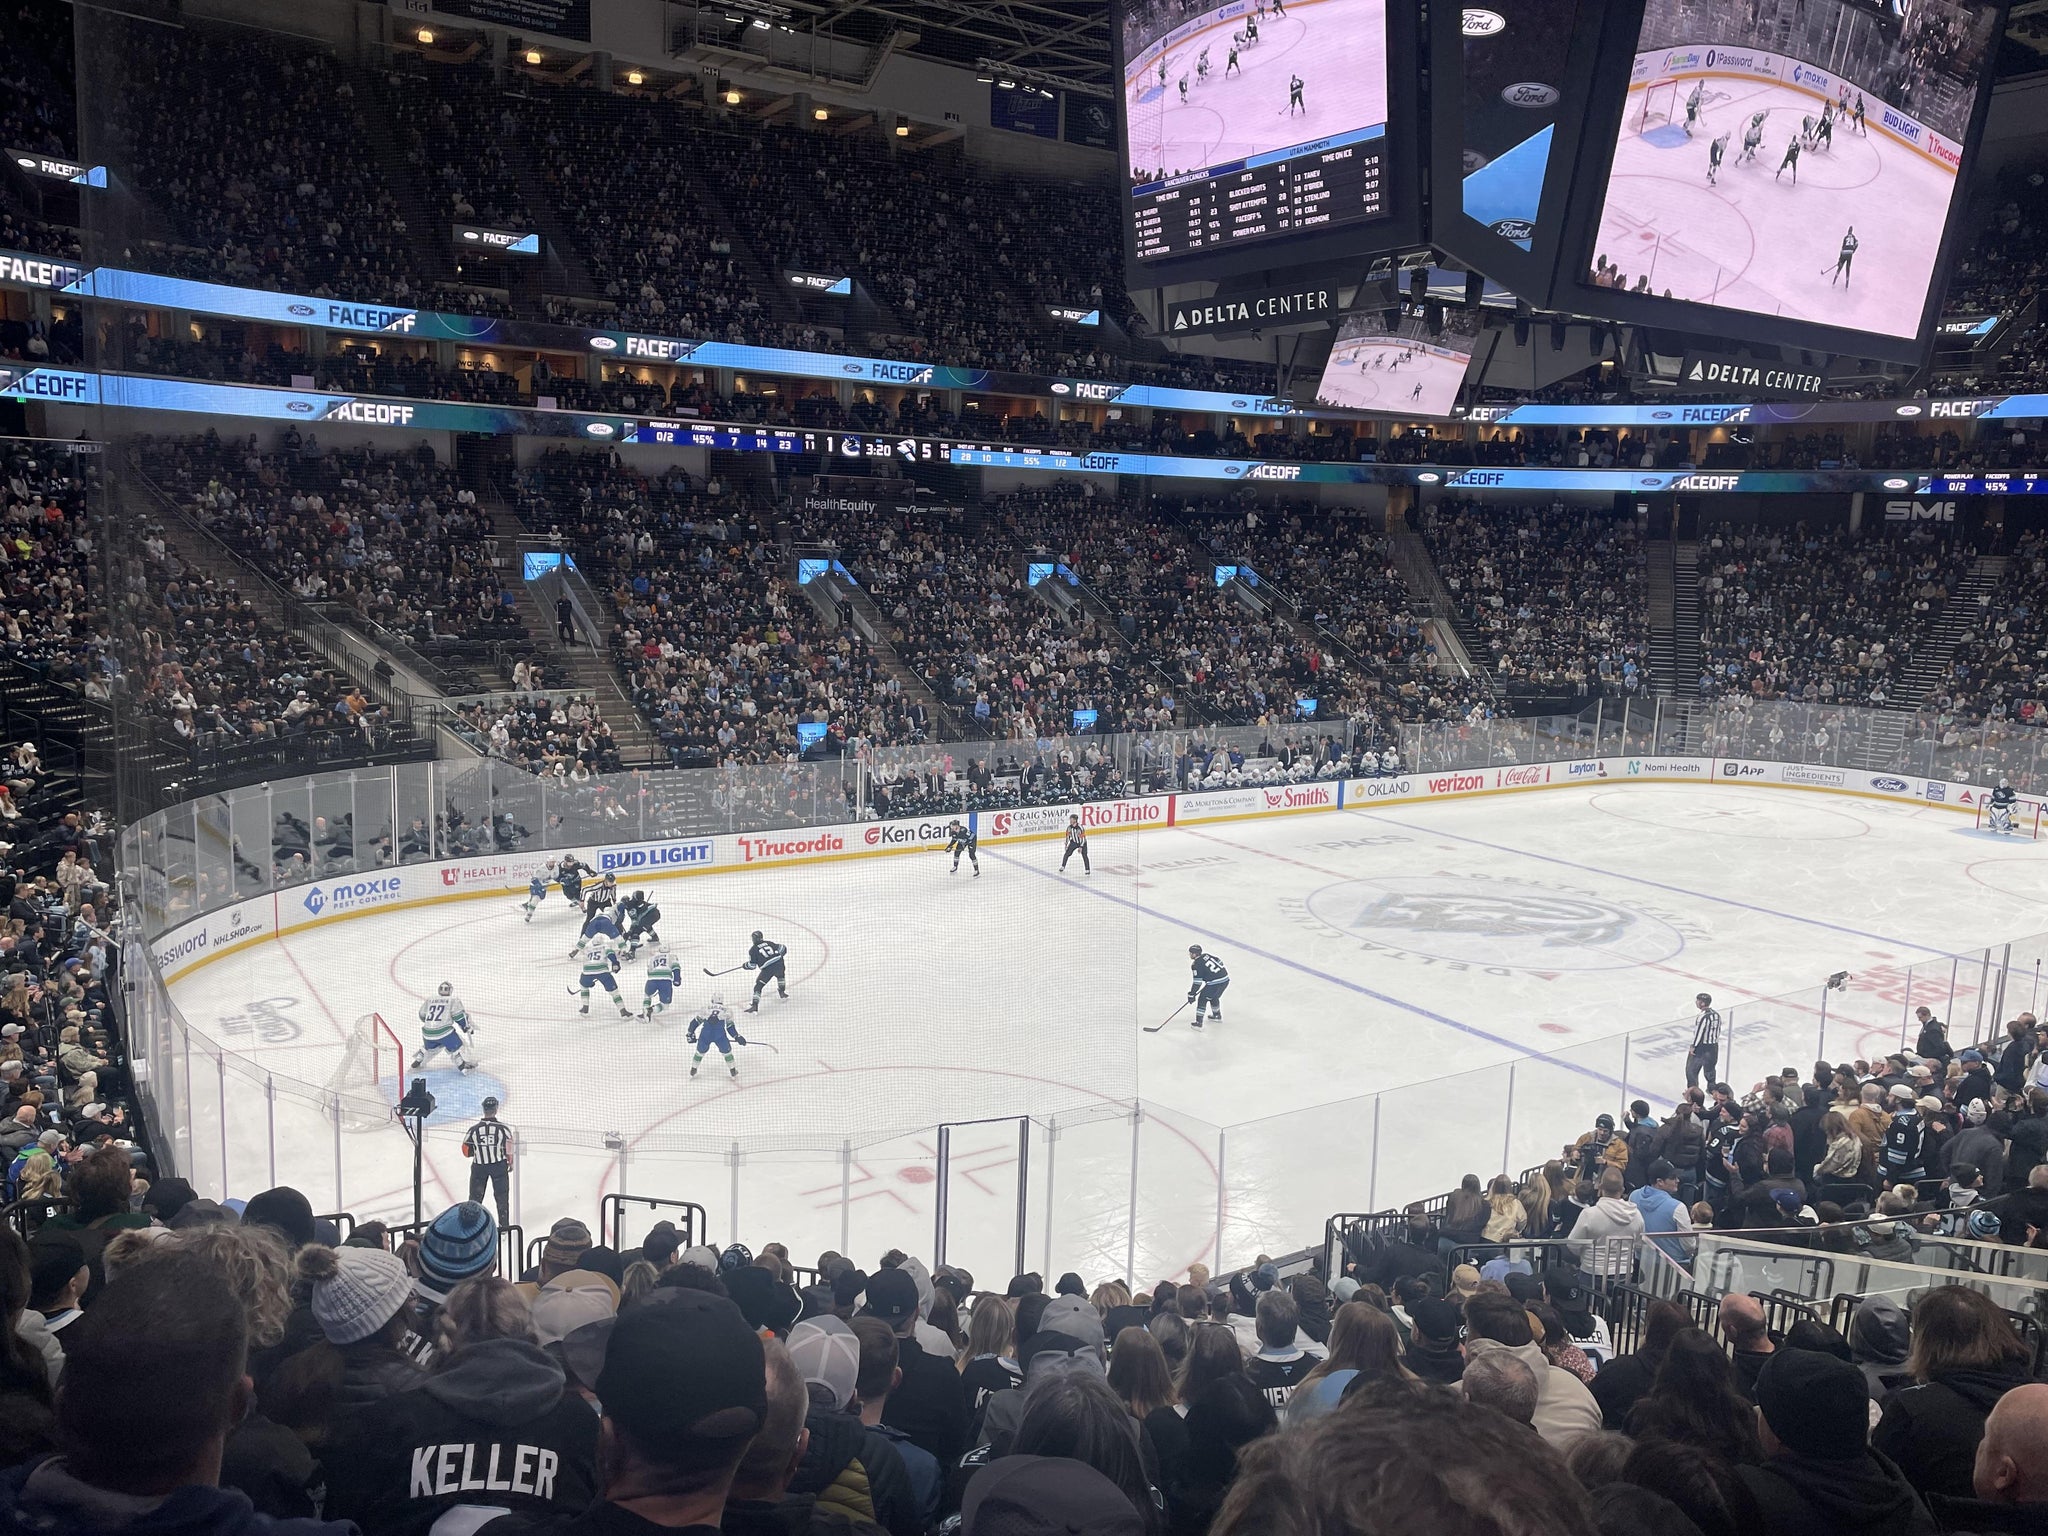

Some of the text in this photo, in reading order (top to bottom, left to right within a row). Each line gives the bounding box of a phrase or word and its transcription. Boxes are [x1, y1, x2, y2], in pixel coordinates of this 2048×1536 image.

[1716, 53, 1753, 68] 1Password
[1804, 69, 1829, 87] moxie
[1884, 111, 1920, 140] BUD LIGHT
[1289, 140, 1330, 156] UTAH MAMMOTH
[1321, 152, 1335, 163] TIME
[1344, 148, 1353, 158] ICE
[1241, 172, 1253, 182] HITS
[1278, 164, 1286, 173] 10
[1294, 156, 1379, 182] 13 TANEV 5:10
[1303, 168, 1379, 191] O'BRIEN 5:10
[1229, 187, 1250, 198] BLOCKED
[1250, 183, 1266, 194] SHOTS
[1304, 180, 1379, 202] STENLUND 9:07
[1210, 207, 1218, 216] 23
[1241, 196, 1267, 209] ATTEMPTS
[1304, 192, 1379, 214] COLE 10:33
[1208, 220, 1220, 228] 45%
[1235, 212, 1256, 223] FACEOFF
[1276, 205, 1289, 215] 55%
[1294, 219, 1303, 227] 57
[1304, 213, 1330, 225] DESIMONE
[1210, 219, 1289, 242] 0/2 POWER PLAYS 1/2
[1191, 290, 1328, 326] DELTA CENTER
[329, 304, 416, 333] FACEOFF
[872, 363, 933, 384] FACEOFF
[1707, 362, 1821, 393] DELTA CENTER
[1682, 407, 1750, 422] FACEOFF
[656, 431, 815, 450] 0/2 45% 7 14 23 11
[826, 436, 833, 452] 1
[865, 443, 892, 457] 3:20
[922, 443, 932, 459] 5
[940, 449, 1067, 467] 16 28 10 4 55% 1/2
[1949, 482, 2034, 492] 0/2 45% 7
[805, 497, 876, 515] HealthEquity
[1884, 501, 1956, 521] SME
[1569, 763, 1596, 776] Layton
[1645, 762, 1701, 773] Nomi Health
[1739, 765, 1765, 778] App
[1786, 764, 1804, 772] JUST
[1428, 774, 1484, 793] verizon
[1786, 771, 1841, 784] INGREDIENTS
[1284, 787, 1329, 808] Smith's
[1368, 781, 1410, 797] OKLAND
[1012, 808, 1070, 822] CRAIG SWAPP
[1081, 801, 1160, 827] Rio Tinto
[882, 825, 915, 844] Ken
[754, 833, 844, 857] Trucordia
[602, 844, 710, 871] BUD LIGHT
[1143, 855, 1230, 870] HEALTH
[463, 865, 506, 879] HEALTH
[333, 876, 401, 902] moxie
[333, 892, 401, 910] PEST CONTROL
[155, 928, 207, 970] assword
[426, 1004, 445, 1022] 32
[1896, 1132, 1905, 1144] 9
[409, 1442, 559, 1500] KELLER
